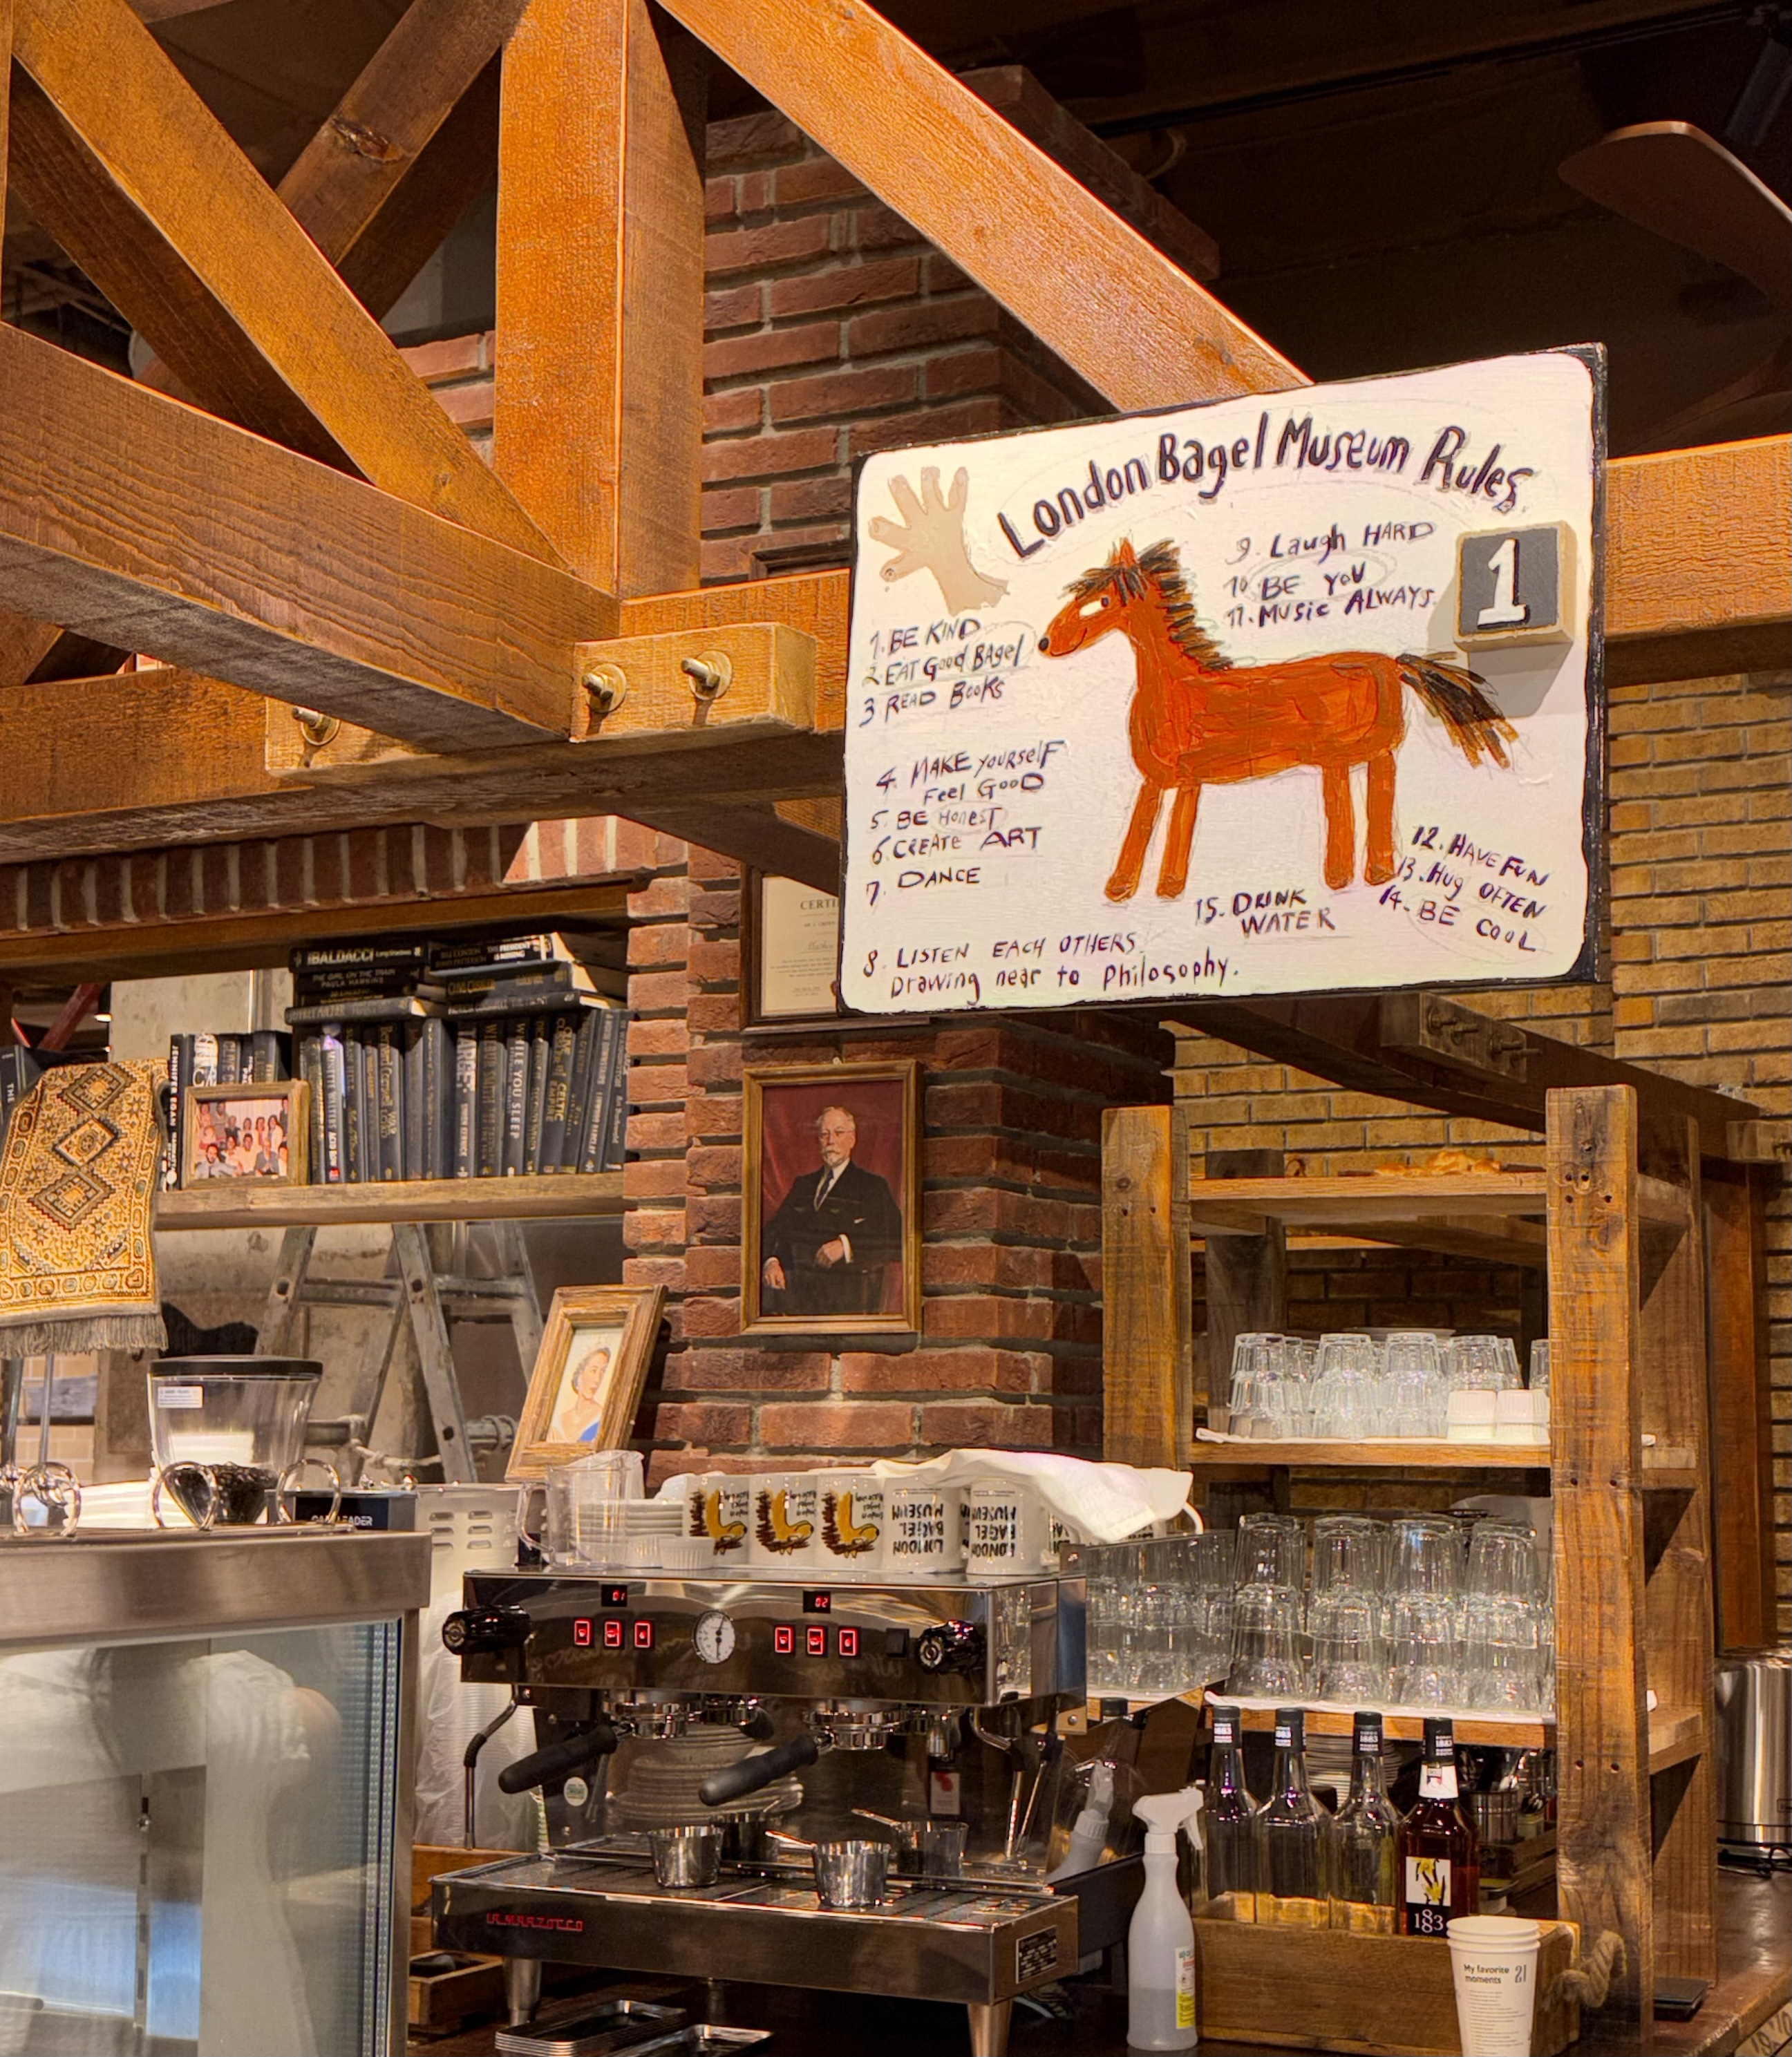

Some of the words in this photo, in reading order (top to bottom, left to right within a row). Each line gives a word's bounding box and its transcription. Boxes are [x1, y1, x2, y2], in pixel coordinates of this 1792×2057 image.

[997, 459, 1149, 558] London
[1158, 412, 1270, 499] Bagel
[1277, 417, 1410, 472] Museum
[1420, 426, 1536, 512] Rules
[1270, 523, 1346, 565] Laugh
[1364, 521, 1435, 547] HARD
[1261, 575, 1300, 601] BE
[1478, 538, 1531, 629] 1
[889, 627, 920, 655] BE
[926, 618, 981, 646] KIND
[885, 658, 921, 686] EAT
[885, 691, 937, 722] READ
[911, 750, 972, 789] MAKE
[897, 811, 929, 830] BE
[980, 826, 1042, 851] ART
[1449, 833, 1498, 869] HAVE
[898, 866, 981, 888] DANCE
[800, 899, 840, 911] CERTI
[1232, 889, 1309, 916] DRINK
[1420, 900, 1460, 927] BE
[1479, 882, 1547, 919] OFTEN
[1242, 907, 1336, 938] WATER
[896, 943, 970, 969] LISTEN
[992, 938, 1046, 958] EACH
[996, 967, 1041, 988] near
[1057, 965, 1079, 987] to
[513, 1023, 526, 1065] WHILE
[170, 1045, 179, 1094] JENNIFER
[511, 1070, 524, 1097] YOU
[169, 1097, 178, 1126] EGAN
[545, 1079, 557, 1123] EMPIRE
[554, 1082, 567, 1122] CELTIC
[509, 1102, 522, 1139] SLEEP
[899, 1521, 944, 1538] BAGEL
[893, 1539, 943, 1555] LONDON
[815, 1597, 829, 1608] 02
[1464, 1964, 1475, 1975] My
[1476, 1964, 1510, 1975] favorite
[1514, 1964, 1527, 1984] 21
[1464, 1975, 1502, 1984] moments
